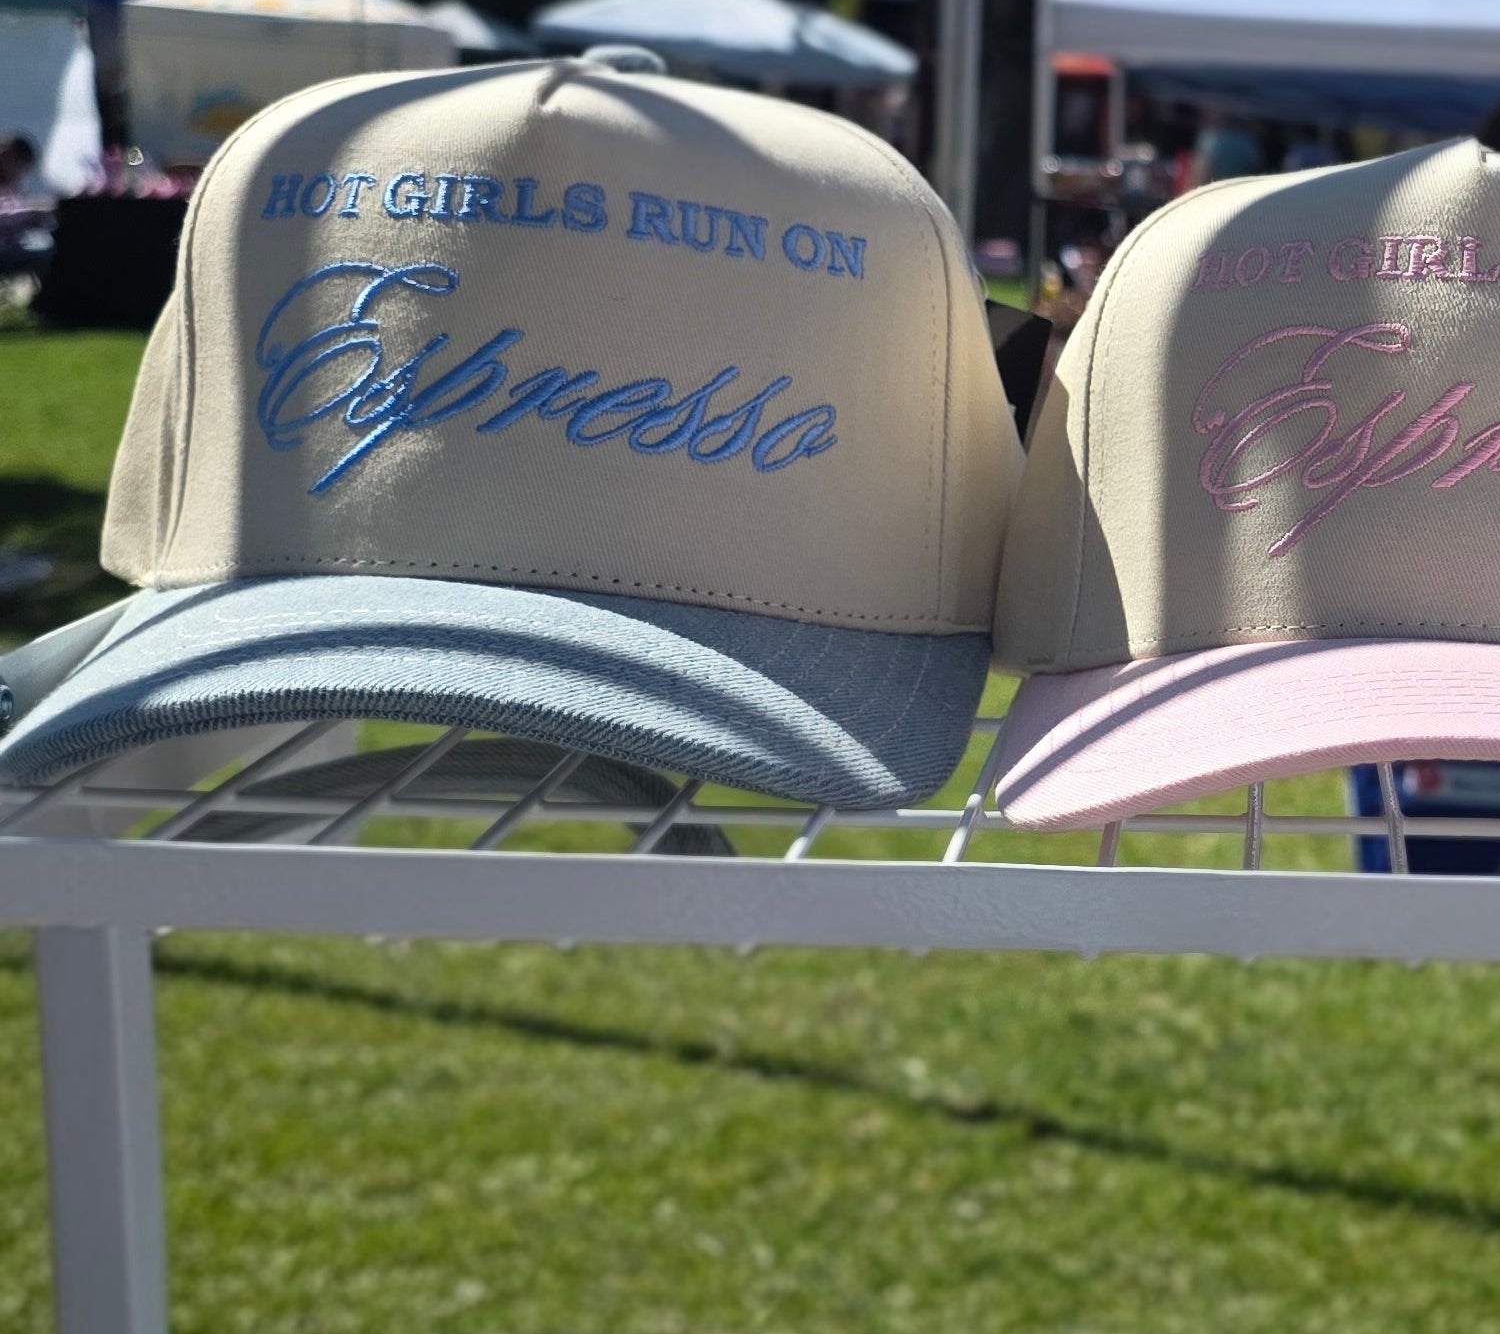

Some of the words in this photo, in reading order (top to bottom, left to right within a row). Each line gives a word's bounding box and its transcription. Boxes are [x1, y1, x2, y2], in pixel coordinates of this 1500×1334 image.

[262, 172, 376, 220] HOT
[383, 171, 608, 232] GIRLS
[626, 191, 769, 259] RUN
[781, 224, 868, 279] ON
[1193, 241, 1315, 293] HOT
[256, 261, 839, 495] Espresso
